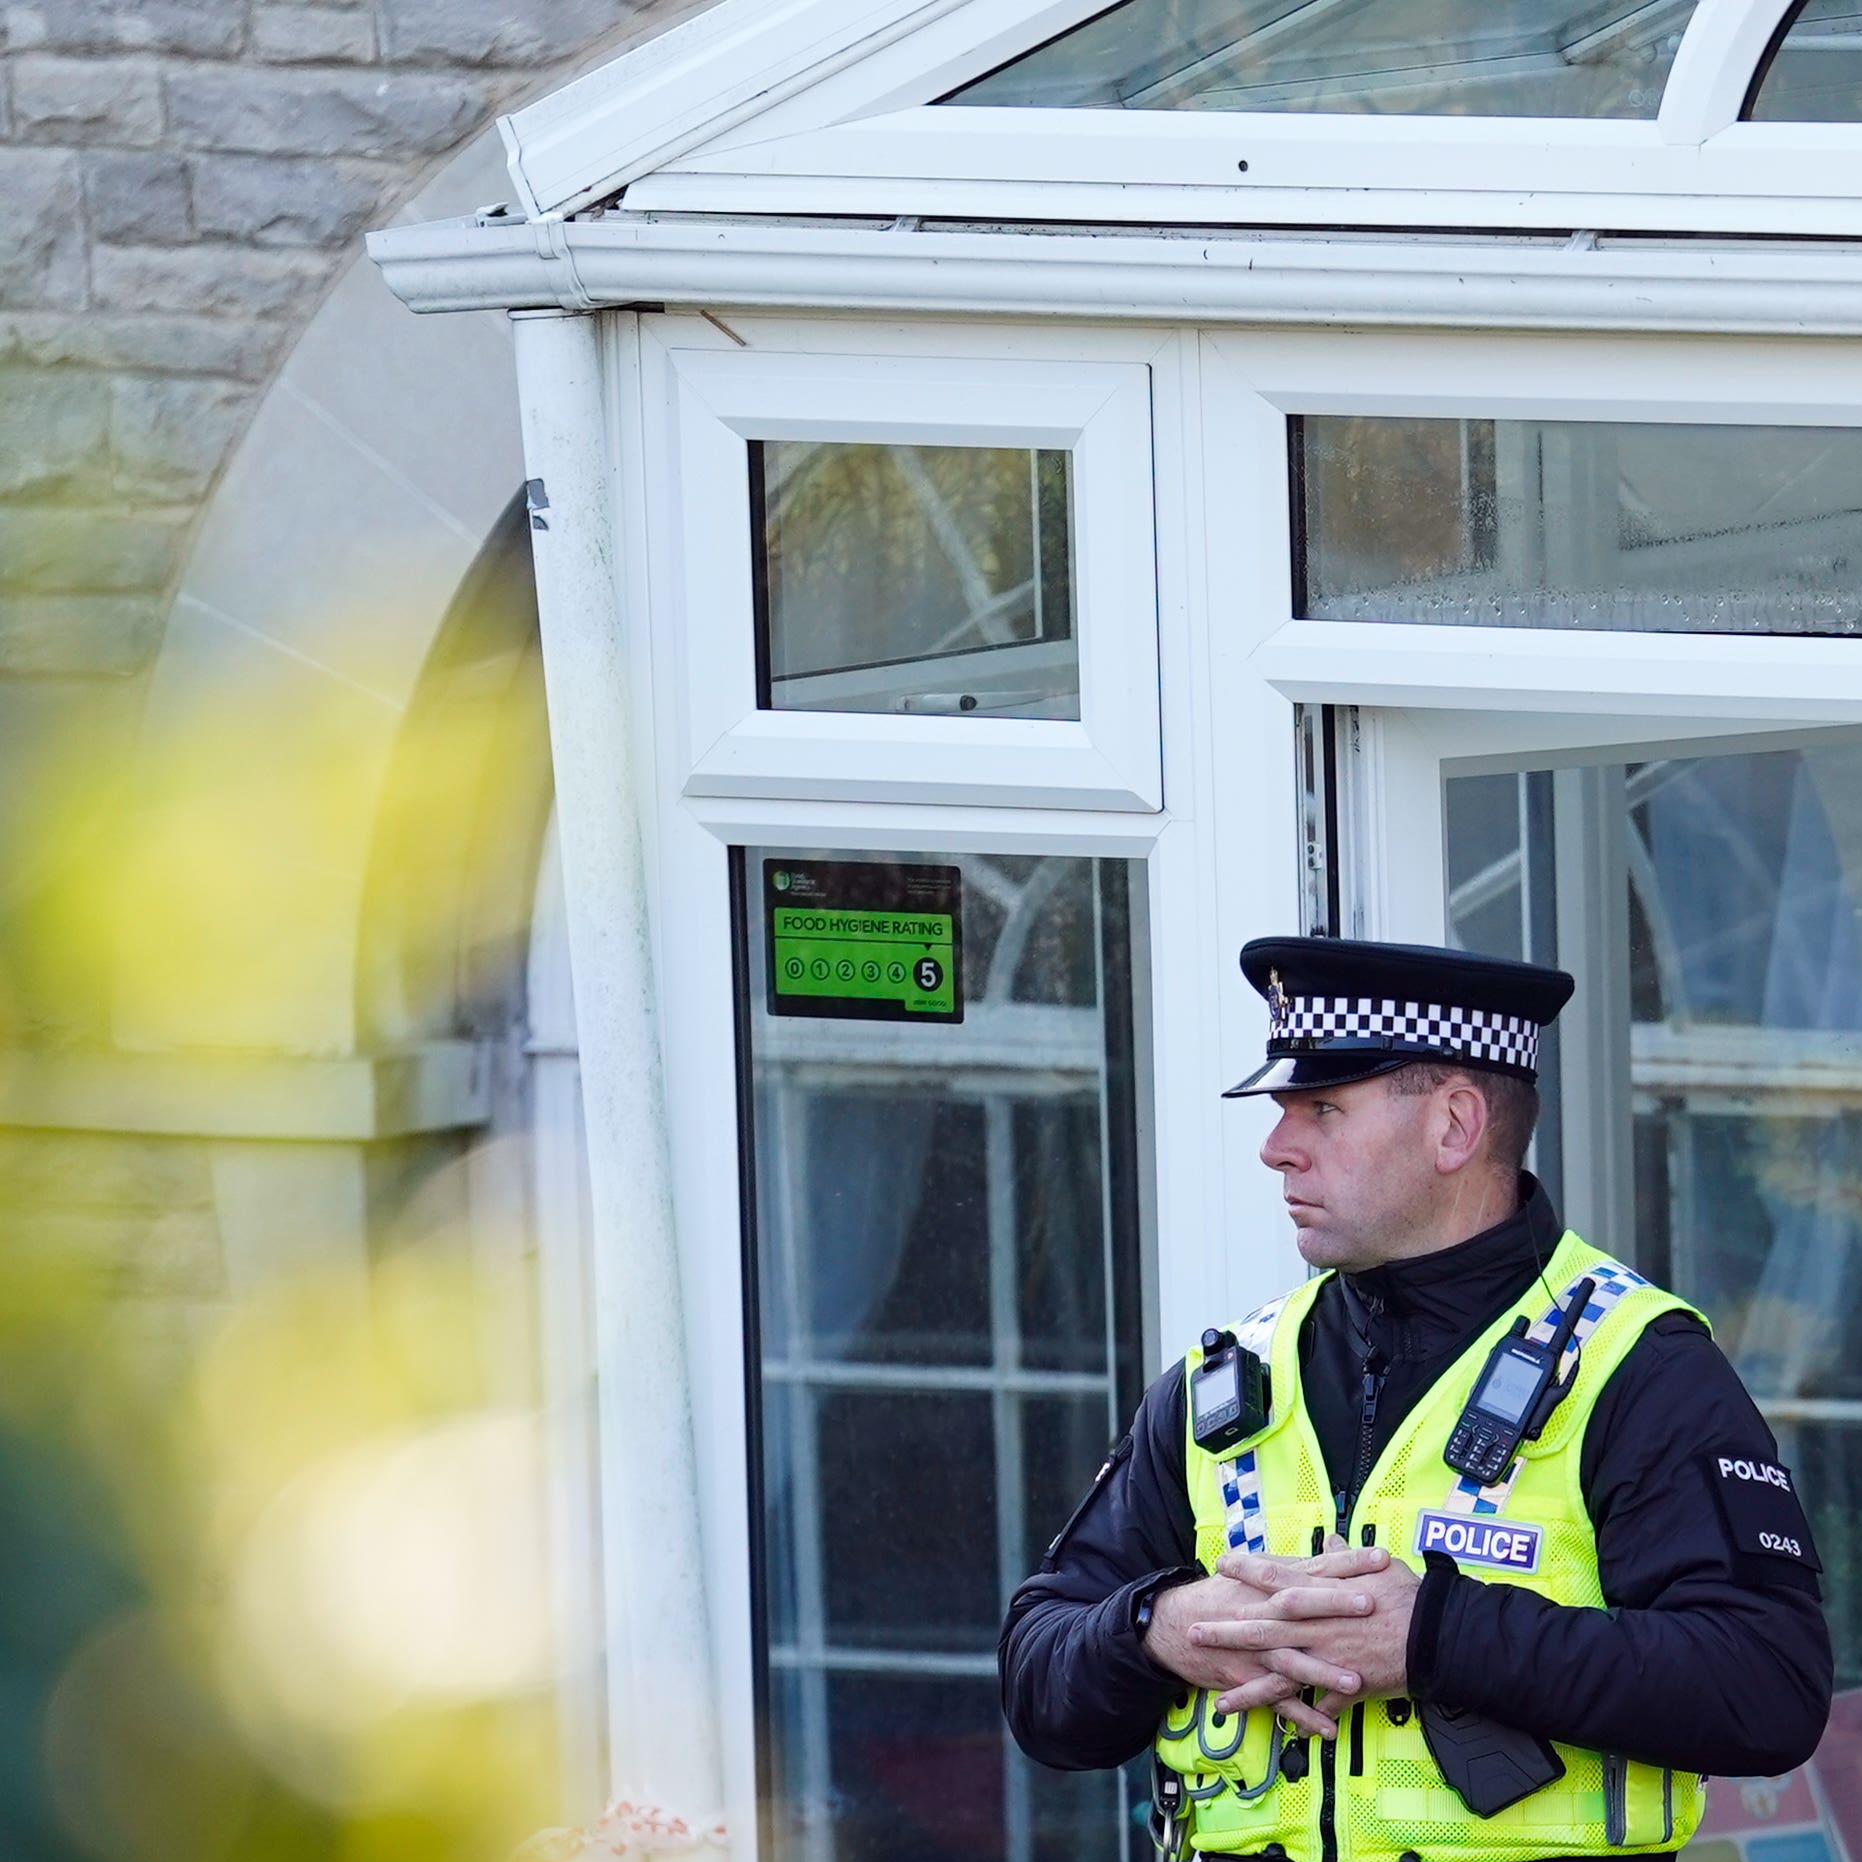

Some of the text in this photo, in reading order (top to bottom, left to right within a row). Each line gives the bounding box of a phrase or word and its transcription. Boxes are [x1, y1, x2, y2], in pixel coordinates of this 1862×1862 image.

[783, 916, 943, 936] FOOD HYGIENE RATING
[920, 961, 937, 987] 5
[1717, 1457, 1791, 1492] POLICE
[1424, 1520, 1531, 1562] POLICE
[1758, 1531, 1802, 1557] 0243
